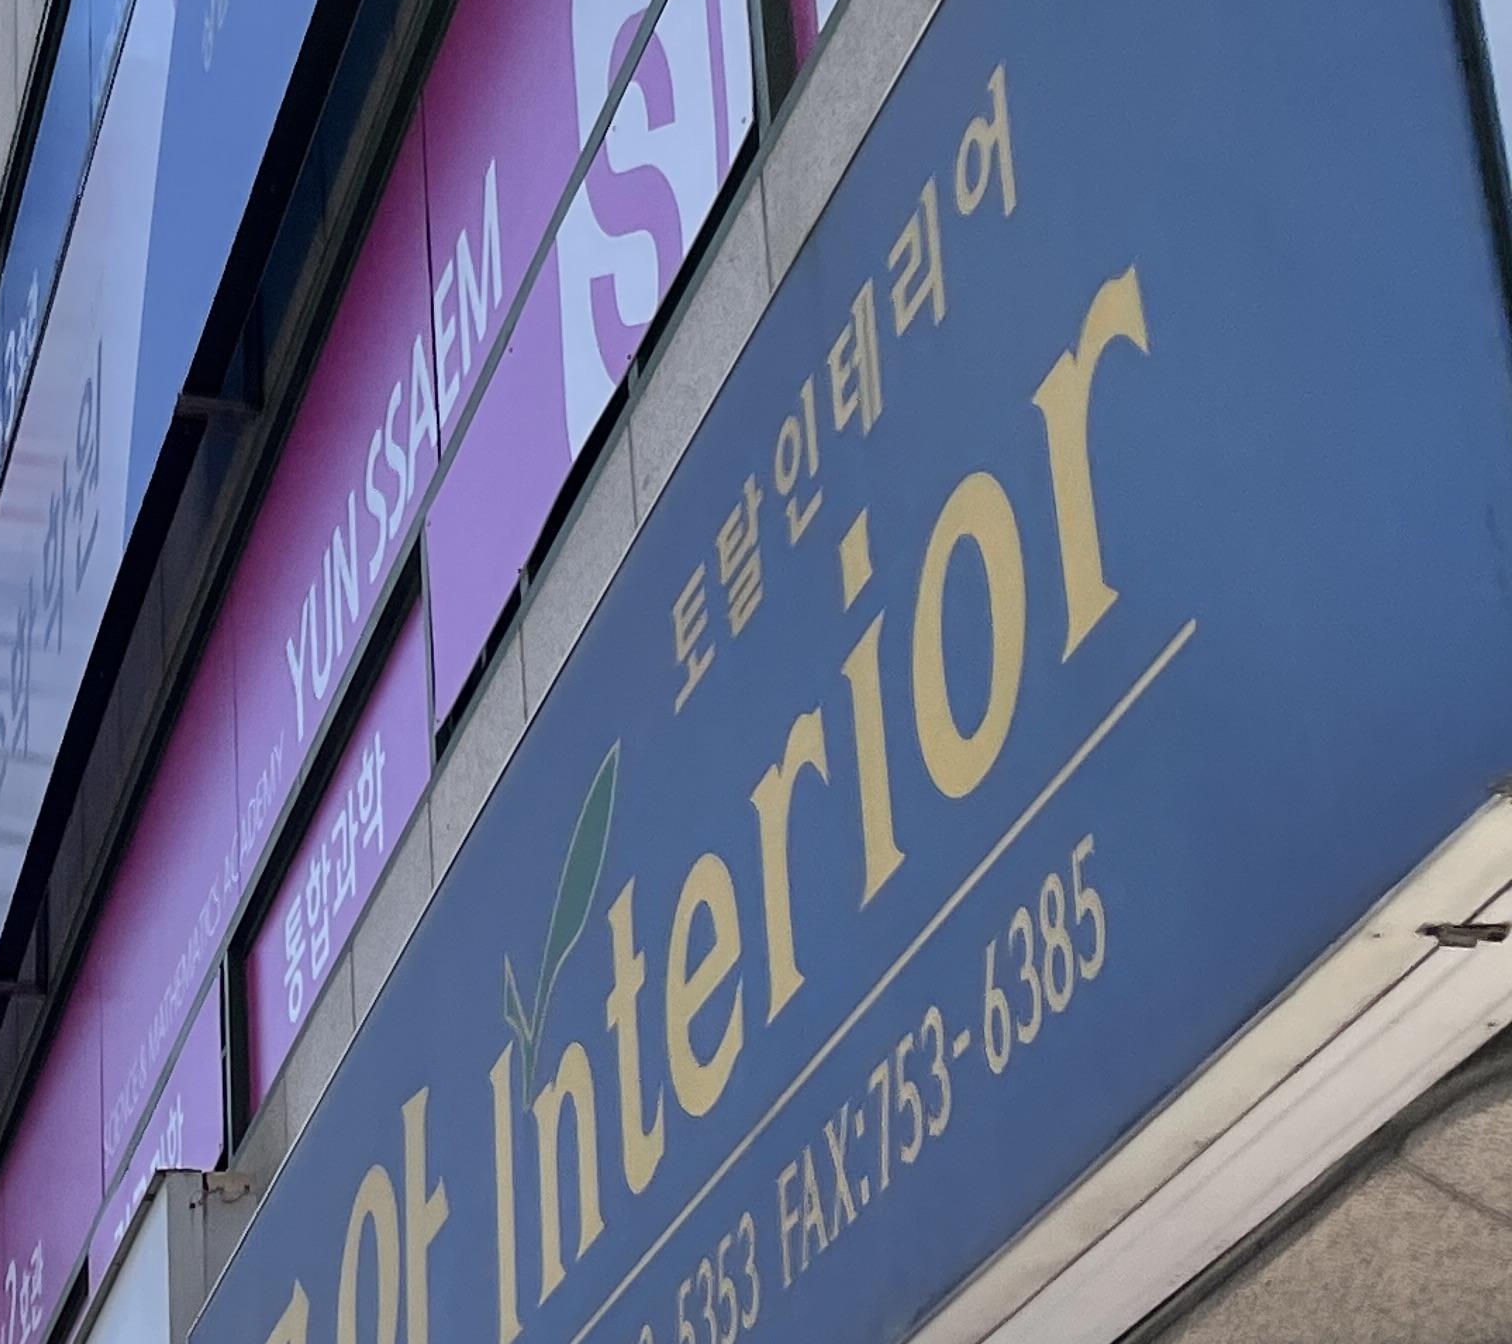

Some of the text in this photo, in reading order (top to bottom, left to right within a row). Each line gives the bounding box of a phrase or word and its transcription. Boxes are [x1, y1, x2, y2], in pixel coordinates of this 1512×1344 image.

[286, 157, 503, 743] YUN SSAEM
[284, 730, 386, 1026] 통합과학
